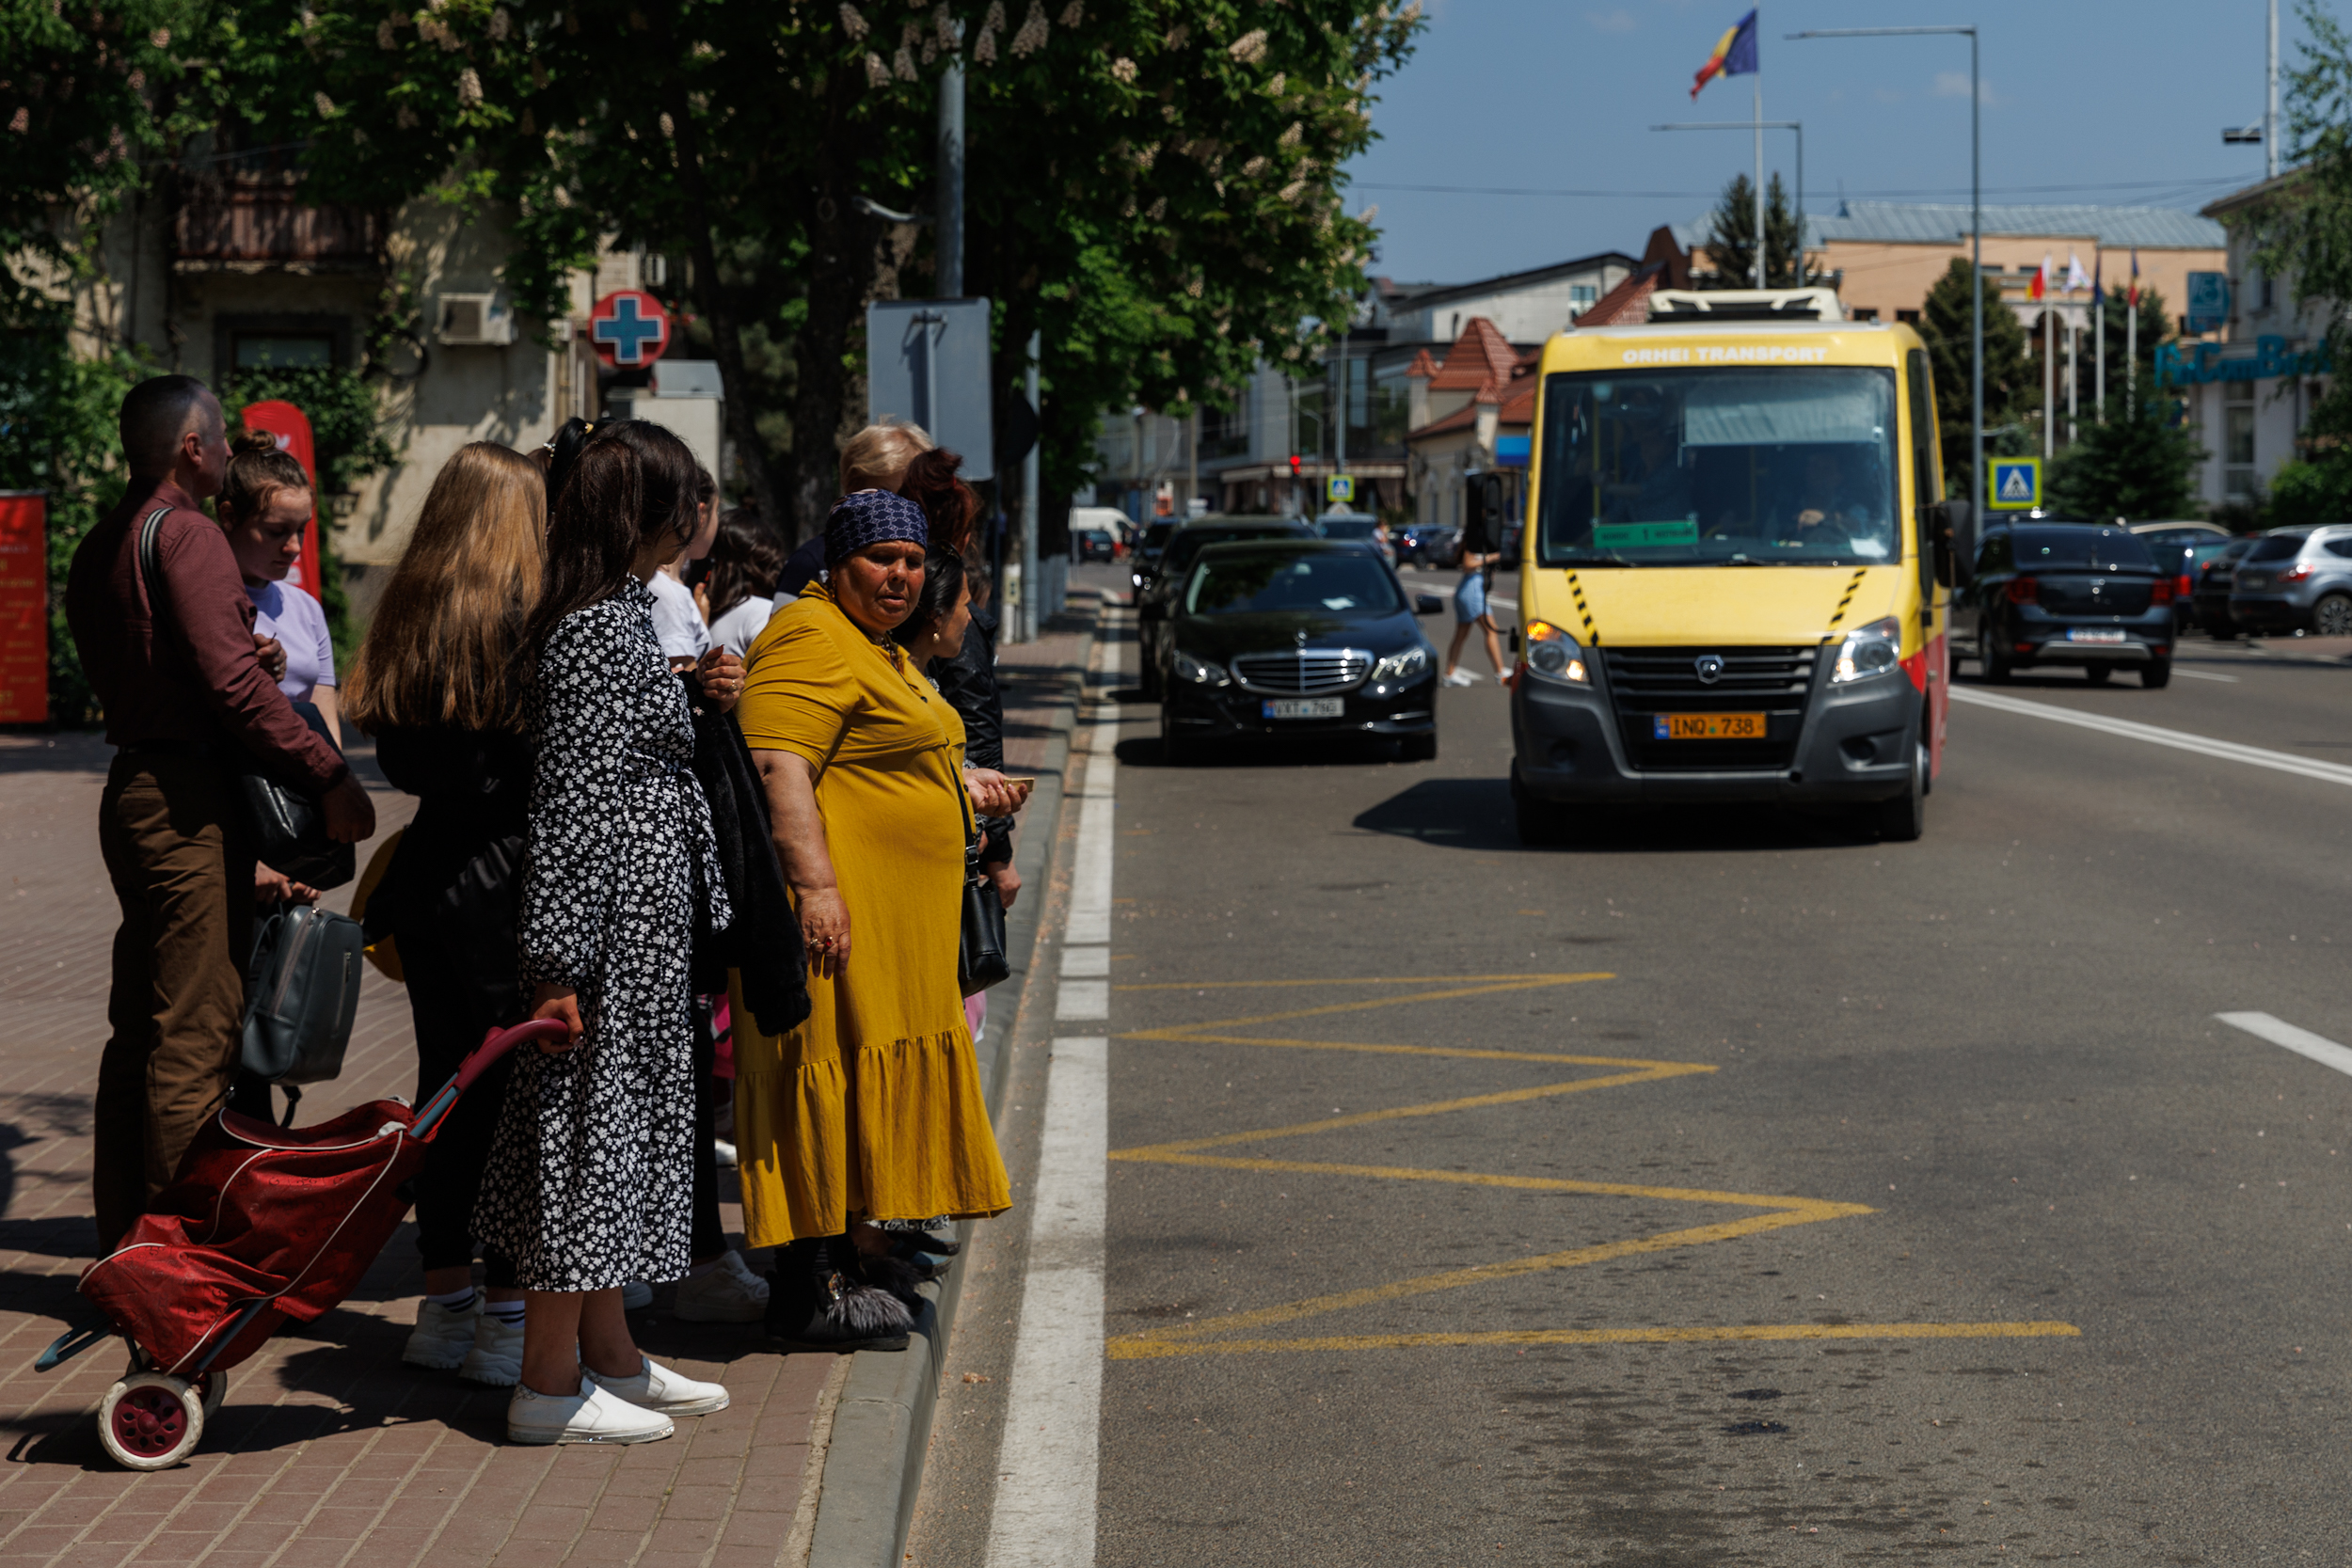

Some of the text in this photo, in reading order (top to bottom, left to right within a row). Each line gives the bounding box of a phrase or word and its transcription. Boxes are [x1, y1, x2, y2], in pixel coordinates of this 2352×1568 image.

[1621, 346, 1827, 364] ORHEI TRANSPORT
[1673, 718, 1706, 736] INQ
[1721, 718, 1754, 736] 738
